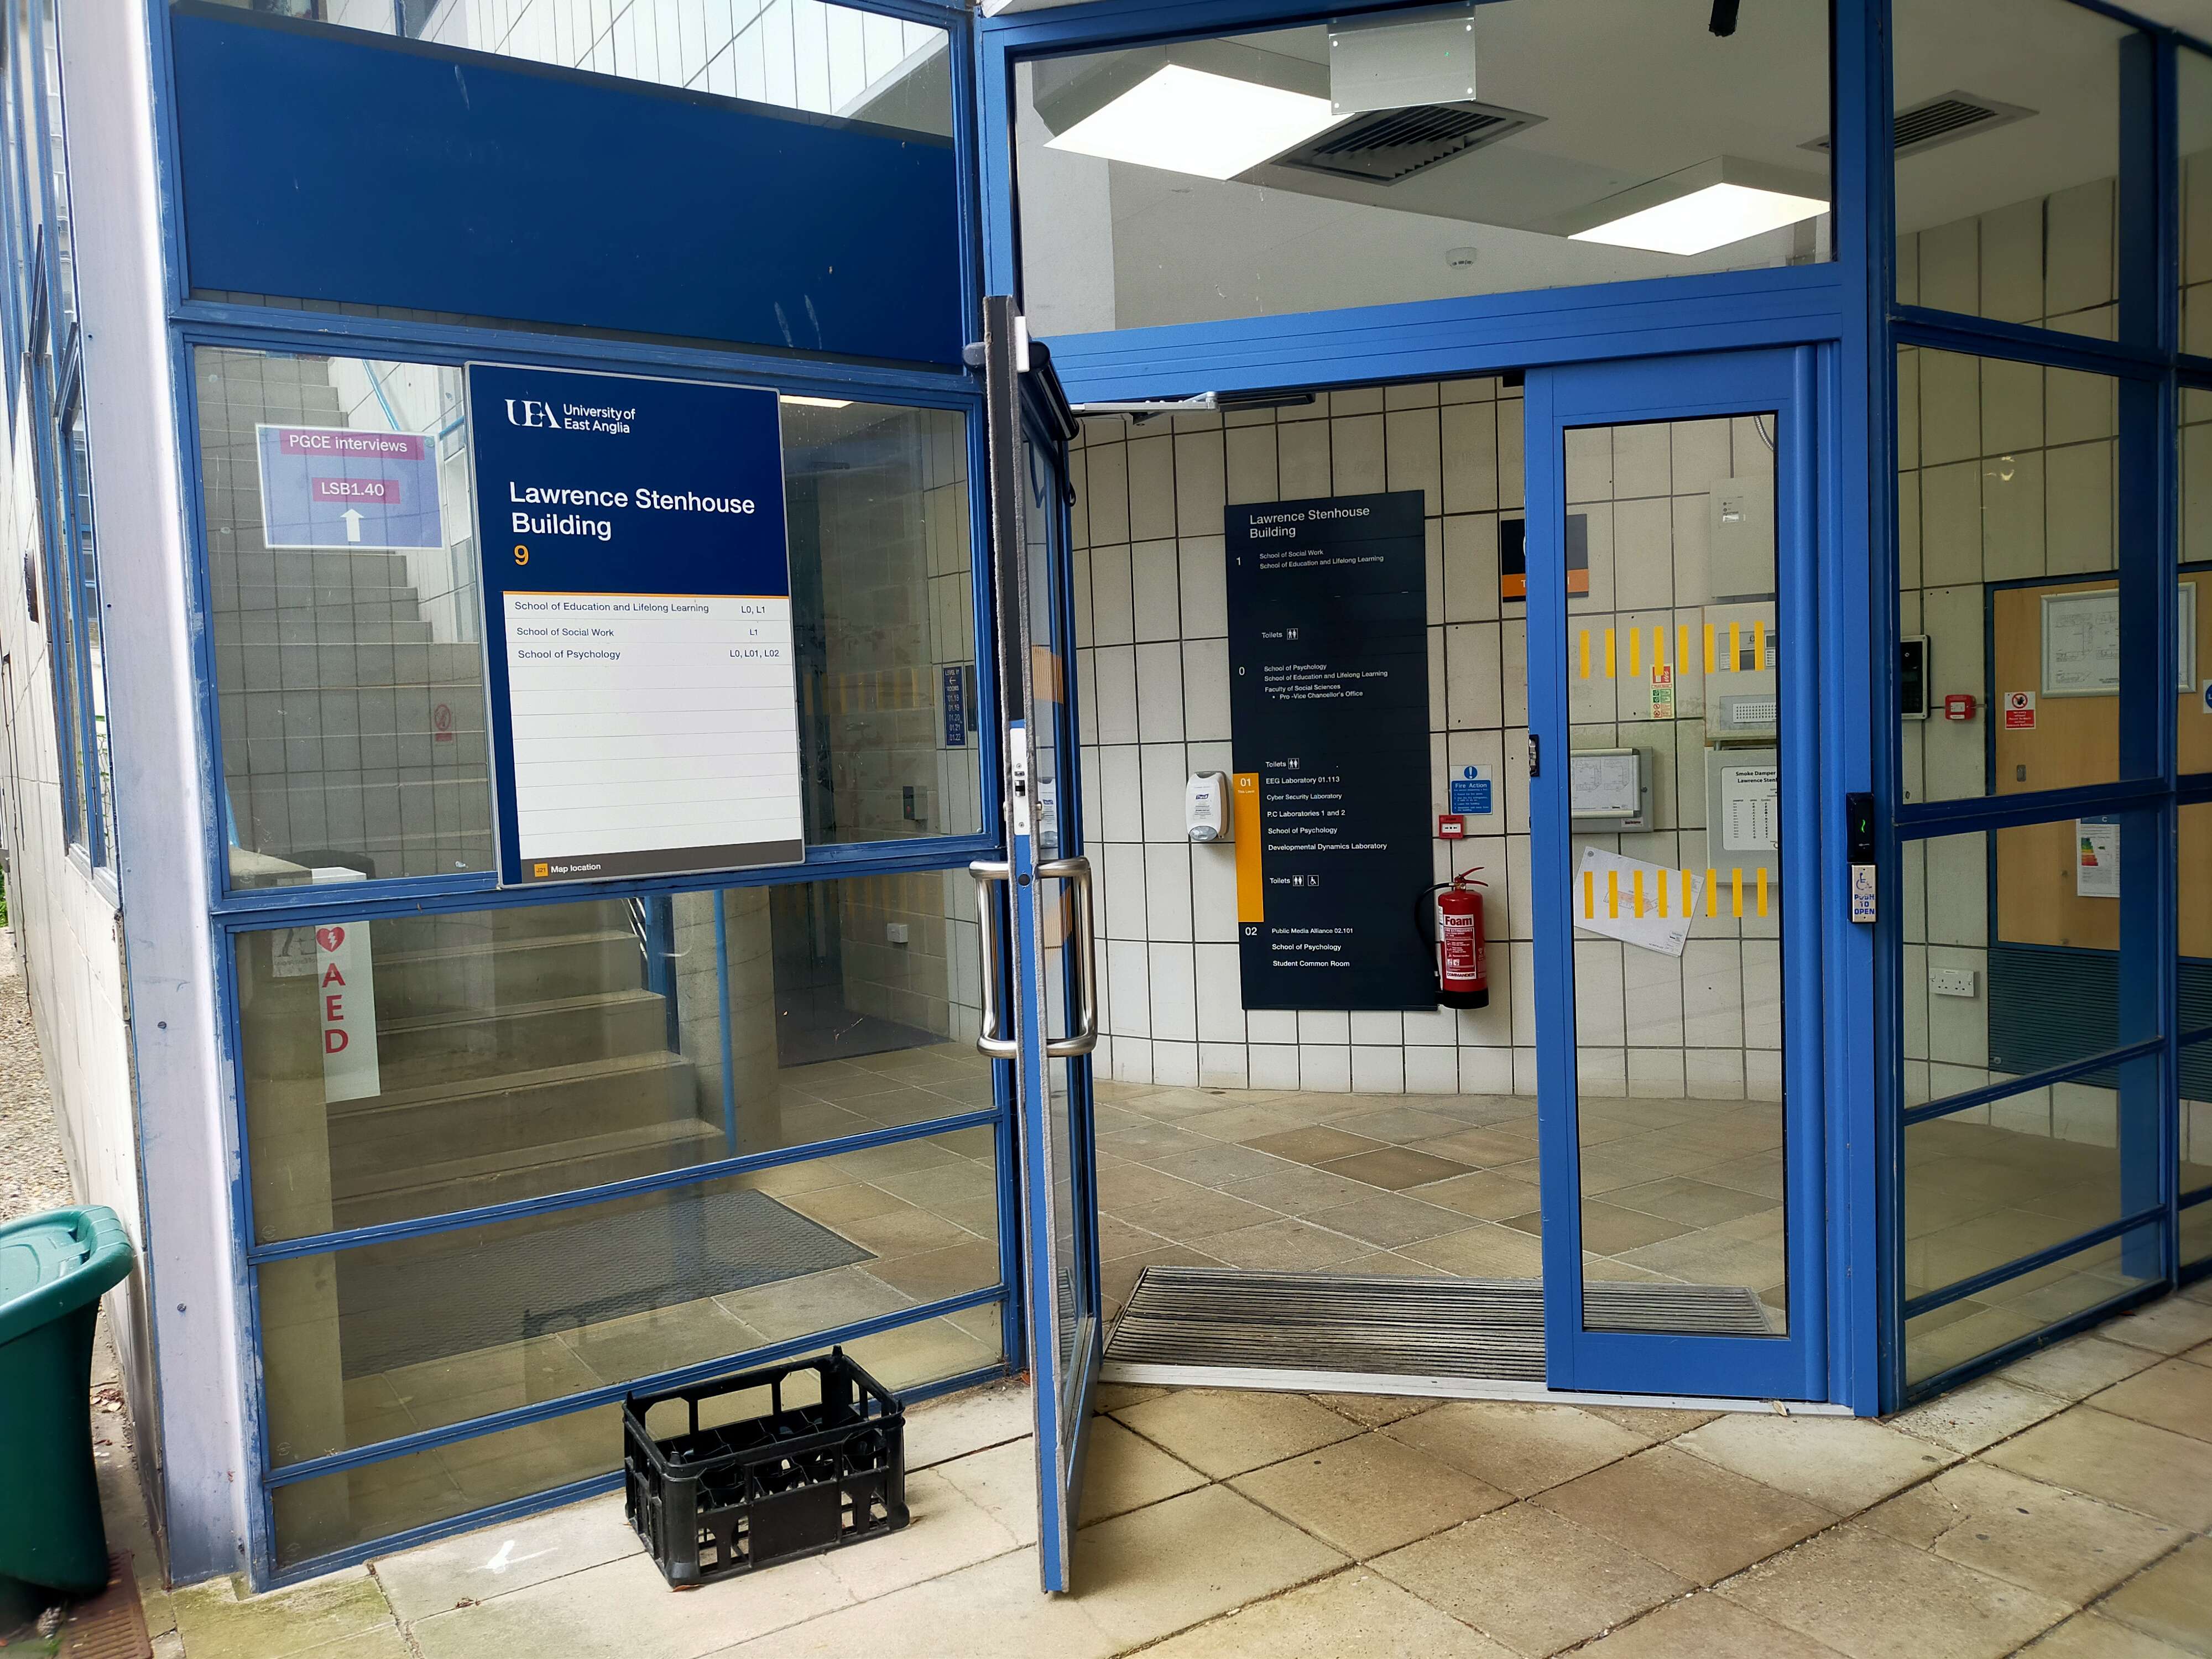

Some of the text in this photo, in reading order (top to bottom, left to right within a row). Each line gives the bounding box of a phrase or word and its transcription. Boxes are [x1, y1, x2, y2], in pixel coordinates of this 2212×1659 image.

[505, 399, 561, 429] UEA
[564, 404, 635, 421] University of
[565, 418, 629, 434] East Anglia
[290, 435, 407, 452] PGCE interviews
[322, 482, 384, 495] LSB1.40
[510, 482, 754, 514] Lawrence Stenhouse
[1250, 508, 1369, 524] Lawrence Stenhouse
[513, 513, 611, 541] Building
[1250, 526, 1295, 538] Building
[514, 545, 529, 566] 9
[515, 602, 547, 610] School
[634, 603, 668, 613] Lifelong
[671, 604, 708, 613] Learning
[567, 650, 620, 660] Psychology
[731, 650, 742, 658] L0,
[745, 650, 761, 658] L01,
[1239, 667, 1244, 675] 0
[1240, 778, 1250, 786] 01
[1446, 916, 1472, 926] Foam
[322, 963, 348, 1054] AED
